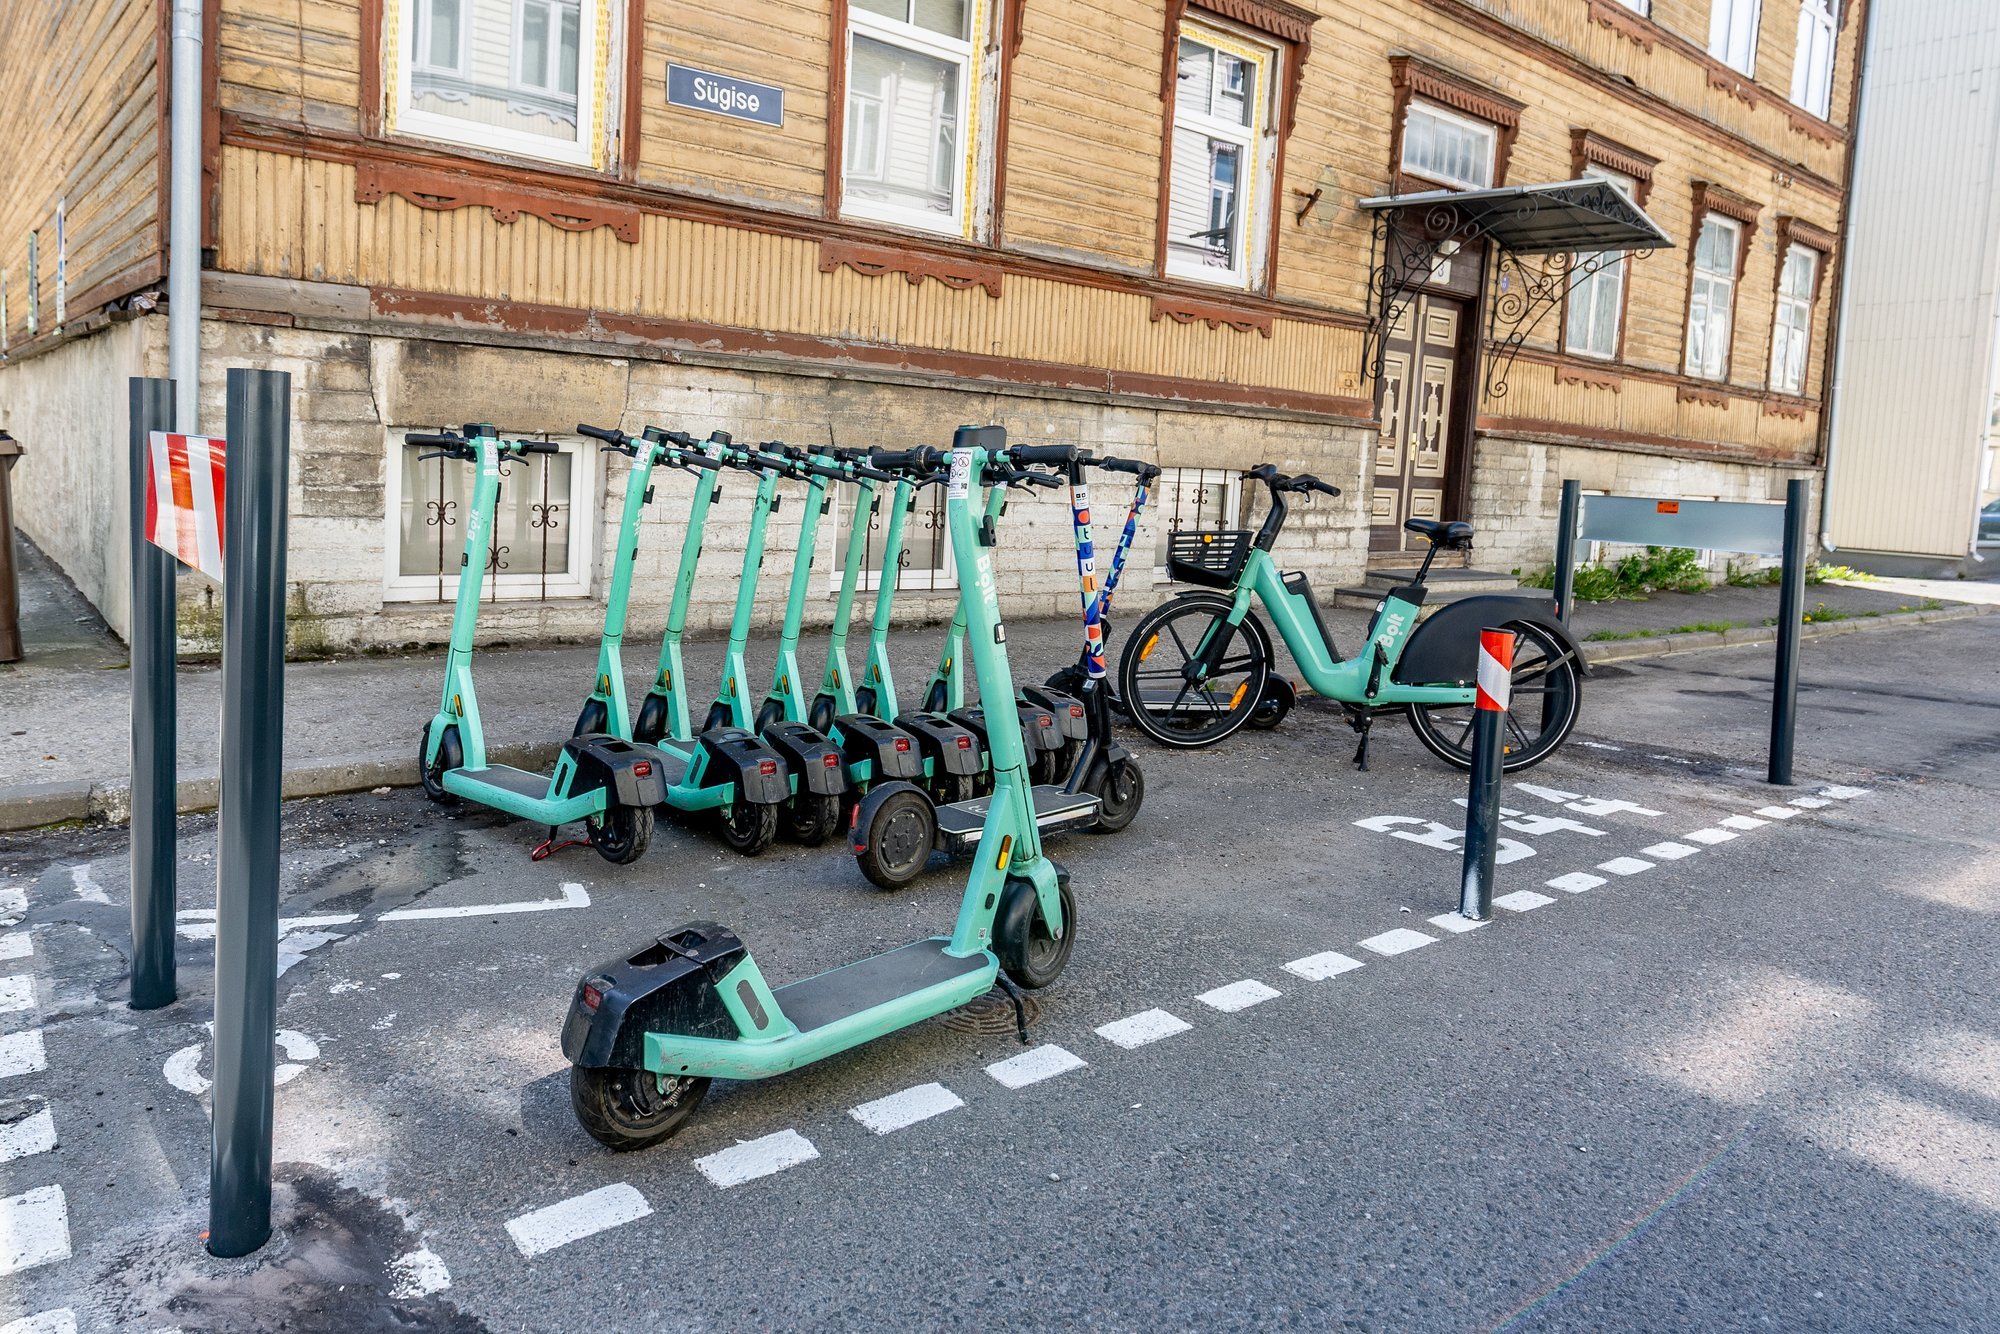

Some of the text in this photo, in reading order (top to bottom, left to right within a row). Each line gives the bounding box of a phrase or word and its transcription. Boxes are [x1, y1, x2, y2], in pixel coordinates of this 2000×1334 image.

[693, 77, 760, 112] Sügise
[467, 509, 481, 541] Bolt
[975, 554, 996, 605] Bolt
[1377, 613, 1405, 648] Bolt
